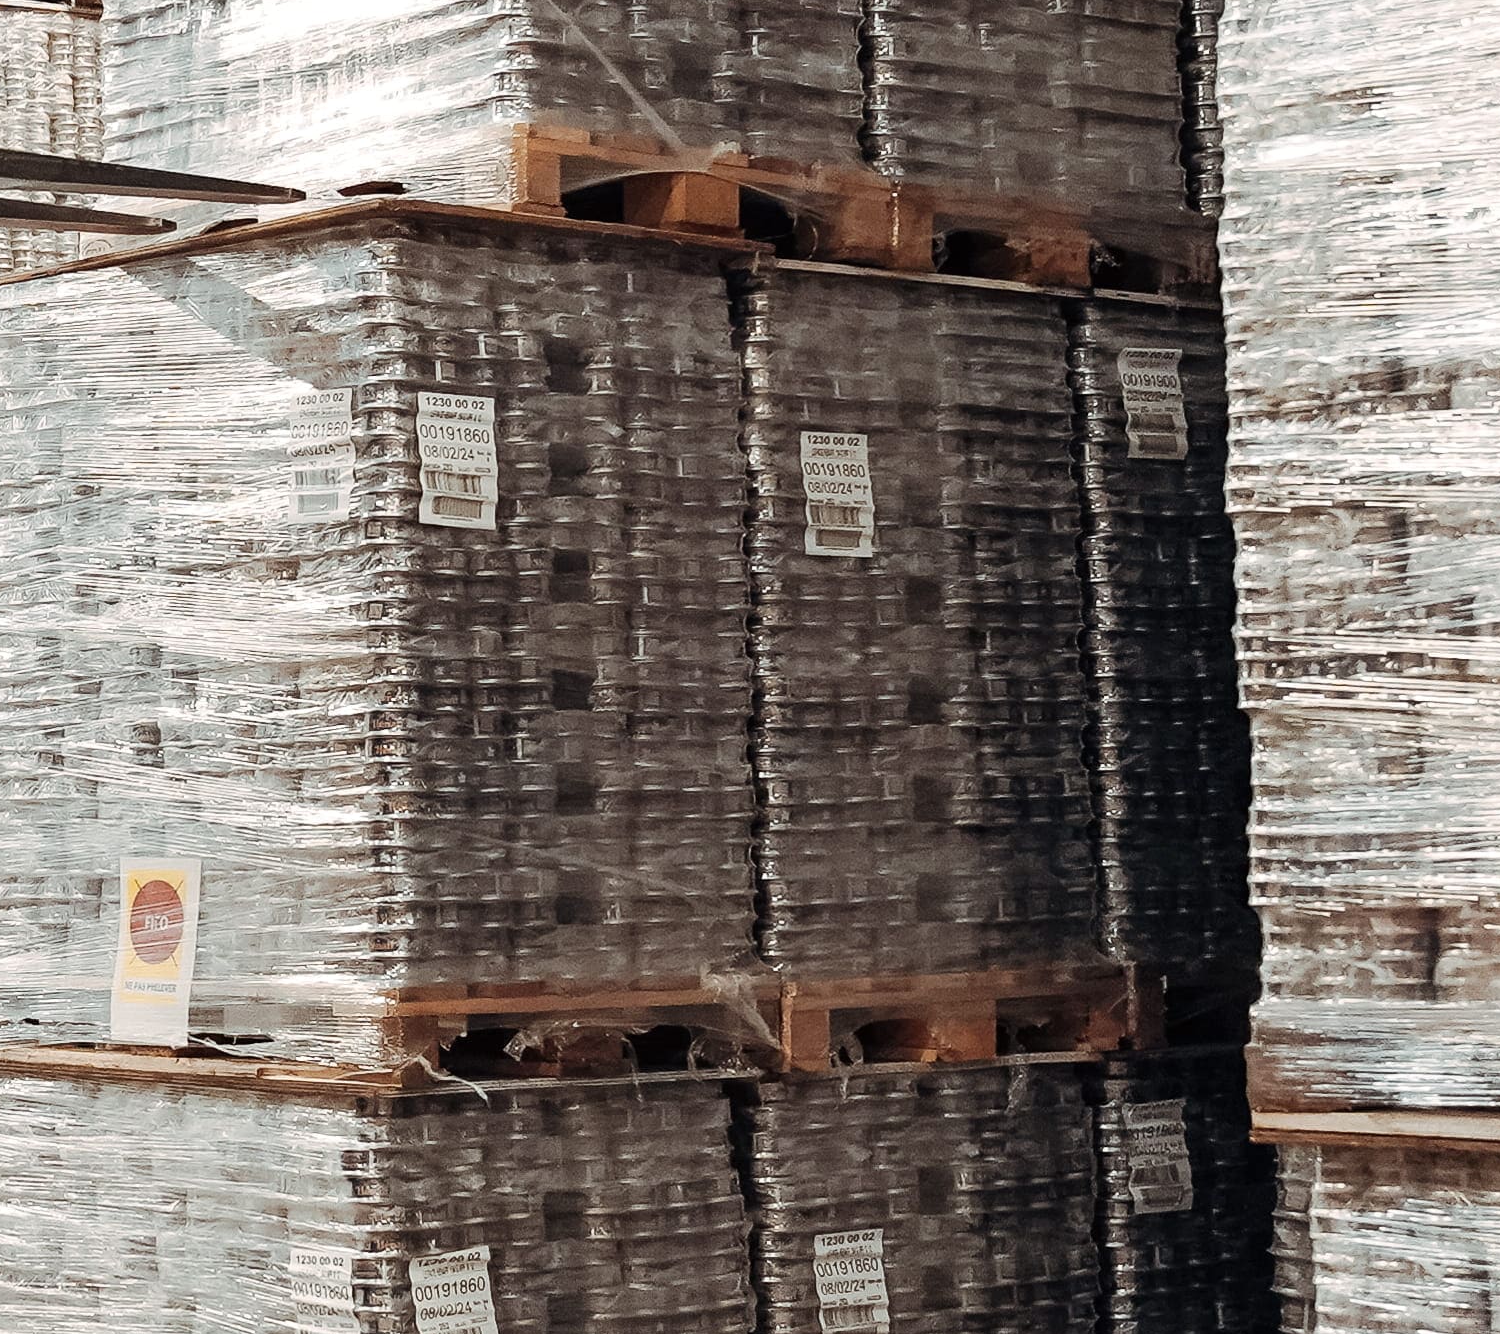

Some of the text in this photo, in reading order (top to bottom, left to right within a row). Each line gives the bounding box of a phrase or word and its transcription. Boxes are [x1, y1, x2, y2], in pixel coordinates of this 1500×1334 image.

[296, 392, 344, 406] 1230 00 02
[425, 396, 485, 410] 1230 00 02
[291, 421, 348, 438] 00191860
[419, 424, 490, 444] 00191860
[807, 435, 860, 447] 1230 00 02
[424, 445, 475, 461] 08/02/24
[804, 461, 865, 478] 00191860
[808, 481, 852, 495] 08/02/24
[821, 1232, 875, 1247] 1230 00 02
[295, 1255, 344, 1267] 1230 00 02
[467, 1251, 481, 1262] 02
[816, 1257, 879, 1278] 00191860
[415, 1276, 486, 1302] 00191860
[820, 1280, 866, 1296] 08/02/24
